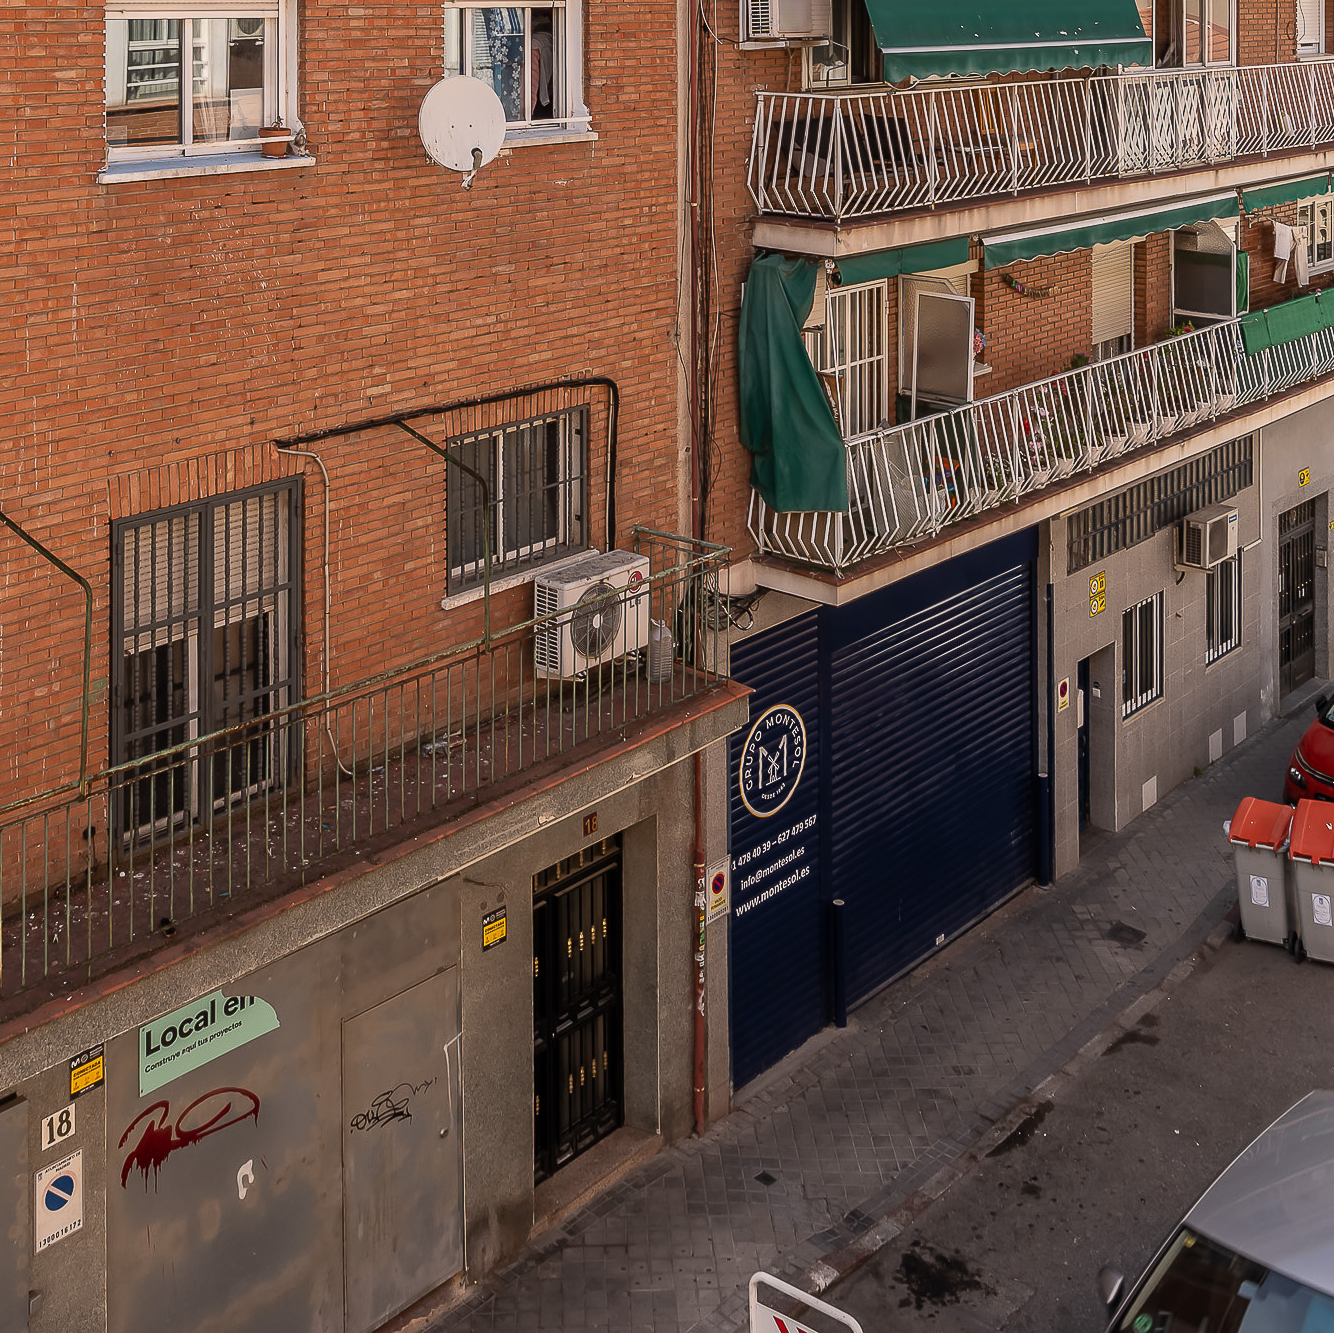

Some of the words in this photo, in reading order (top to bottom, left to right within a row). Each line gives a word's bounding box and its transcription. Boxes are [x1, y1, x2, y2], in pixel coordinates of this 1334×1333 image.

[744, 730, 762, 791] GRUPO
[765, 713, 802, 768] MONTESOL
[585, 815, 598, 834] 18
[737, 852, 751, 867] 478
[752, 846, 762, 858] 40
[762, 840, 771, 854] 39
[777, 829, 791, 844] 627
[791, 822, 804, 836] 479
[804, 814, 817, 829] 567
[735, 865, 810, 917] www.montesol.es
[740, 846, 805, 891] info@montesol.es
[144, 1050, 181, 1073] Construye
[197, 1037, 209, 1047] tus
[209, 1019, 243, 1043] proyectos
[145, 998, 216, 1057] Local
[46, 1108, 72, 1145] 18
